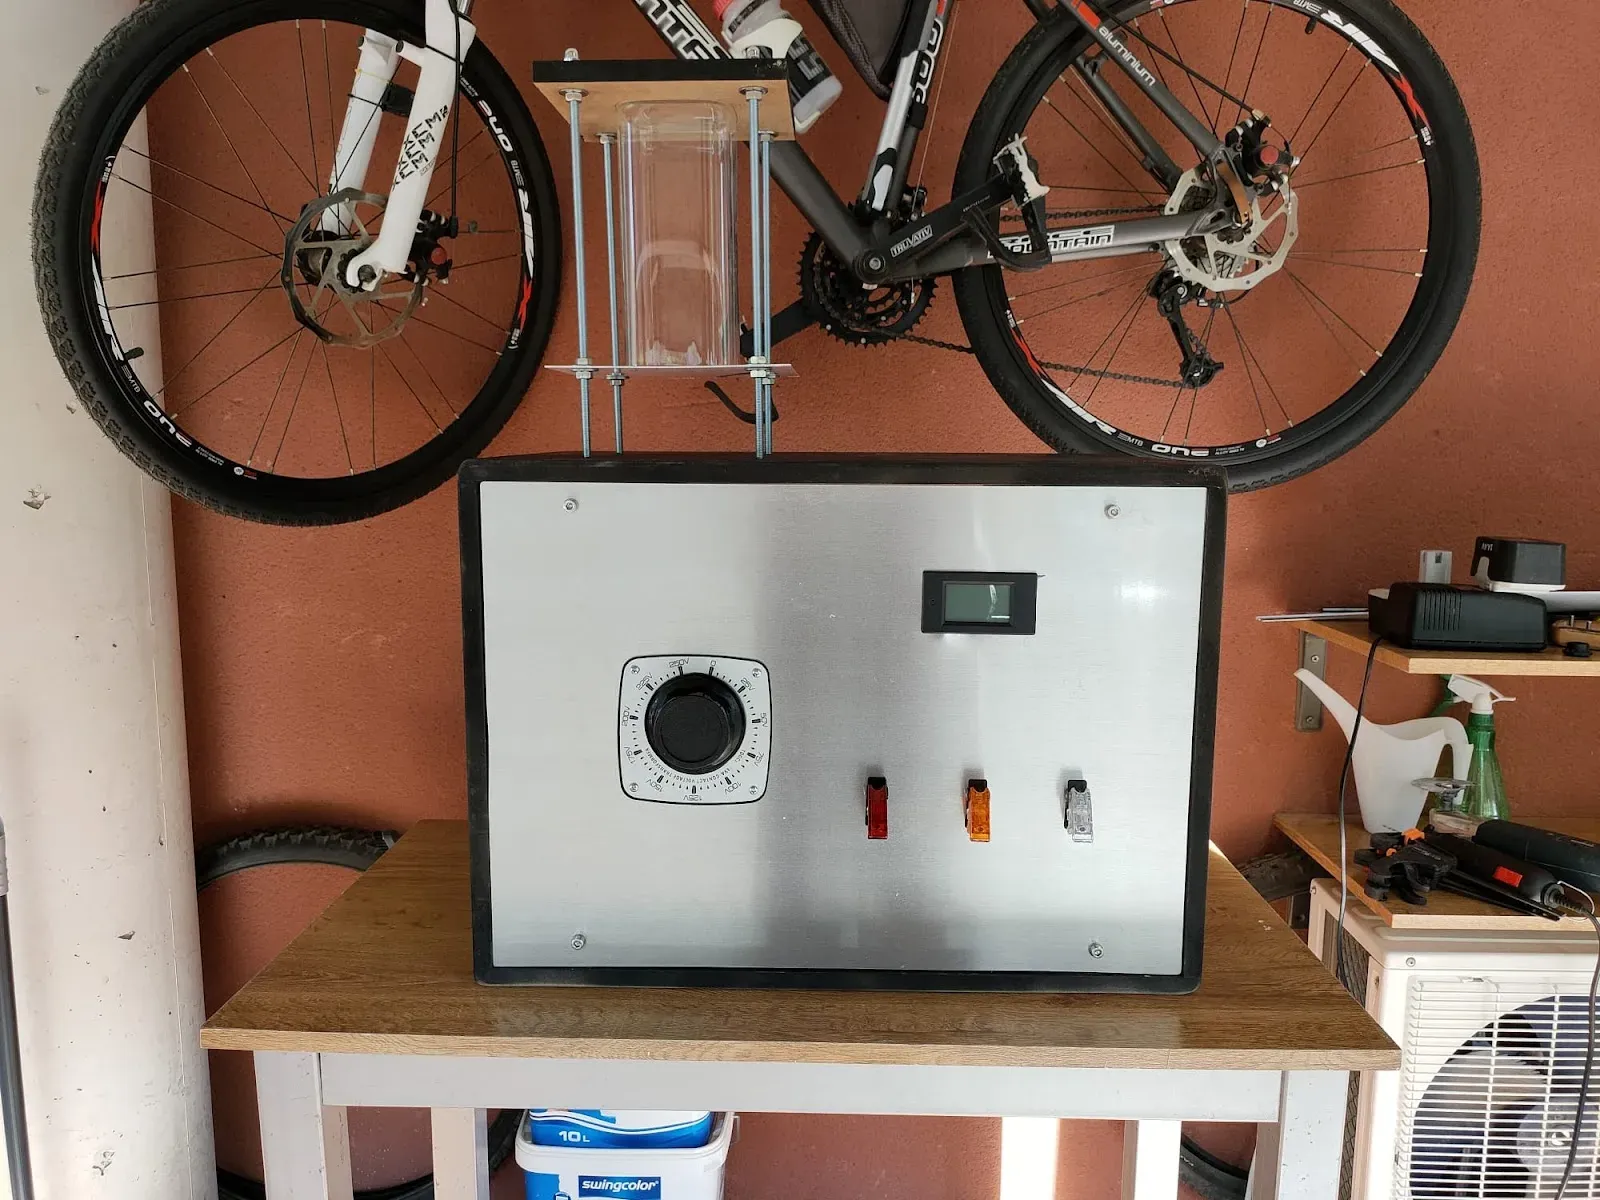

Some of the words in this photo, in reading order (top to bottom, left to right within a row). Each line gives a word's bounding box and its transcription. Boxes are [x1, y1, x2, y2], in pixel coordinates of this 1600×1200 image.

[1099, 26, 1156, 87] aluminium
[669, 657, 690, 668] 250V
[635, 672, 653, 691] 225V
[740, 677, 756, 691] 25V
[621, 705, 631, 727] 200V
[760, 712, 769, 728] 50V
[623, 746, 636, 764] 175V
[753, 751, 765, 767] 75V
[645, 778, 663, 792] 150V
[724, 781, 742, 795] 100V
[558, 1130, 581, 1142] 10
[582, 1135, 590, 1143] L
[582, 1180, 656, 1193] swingcolor
